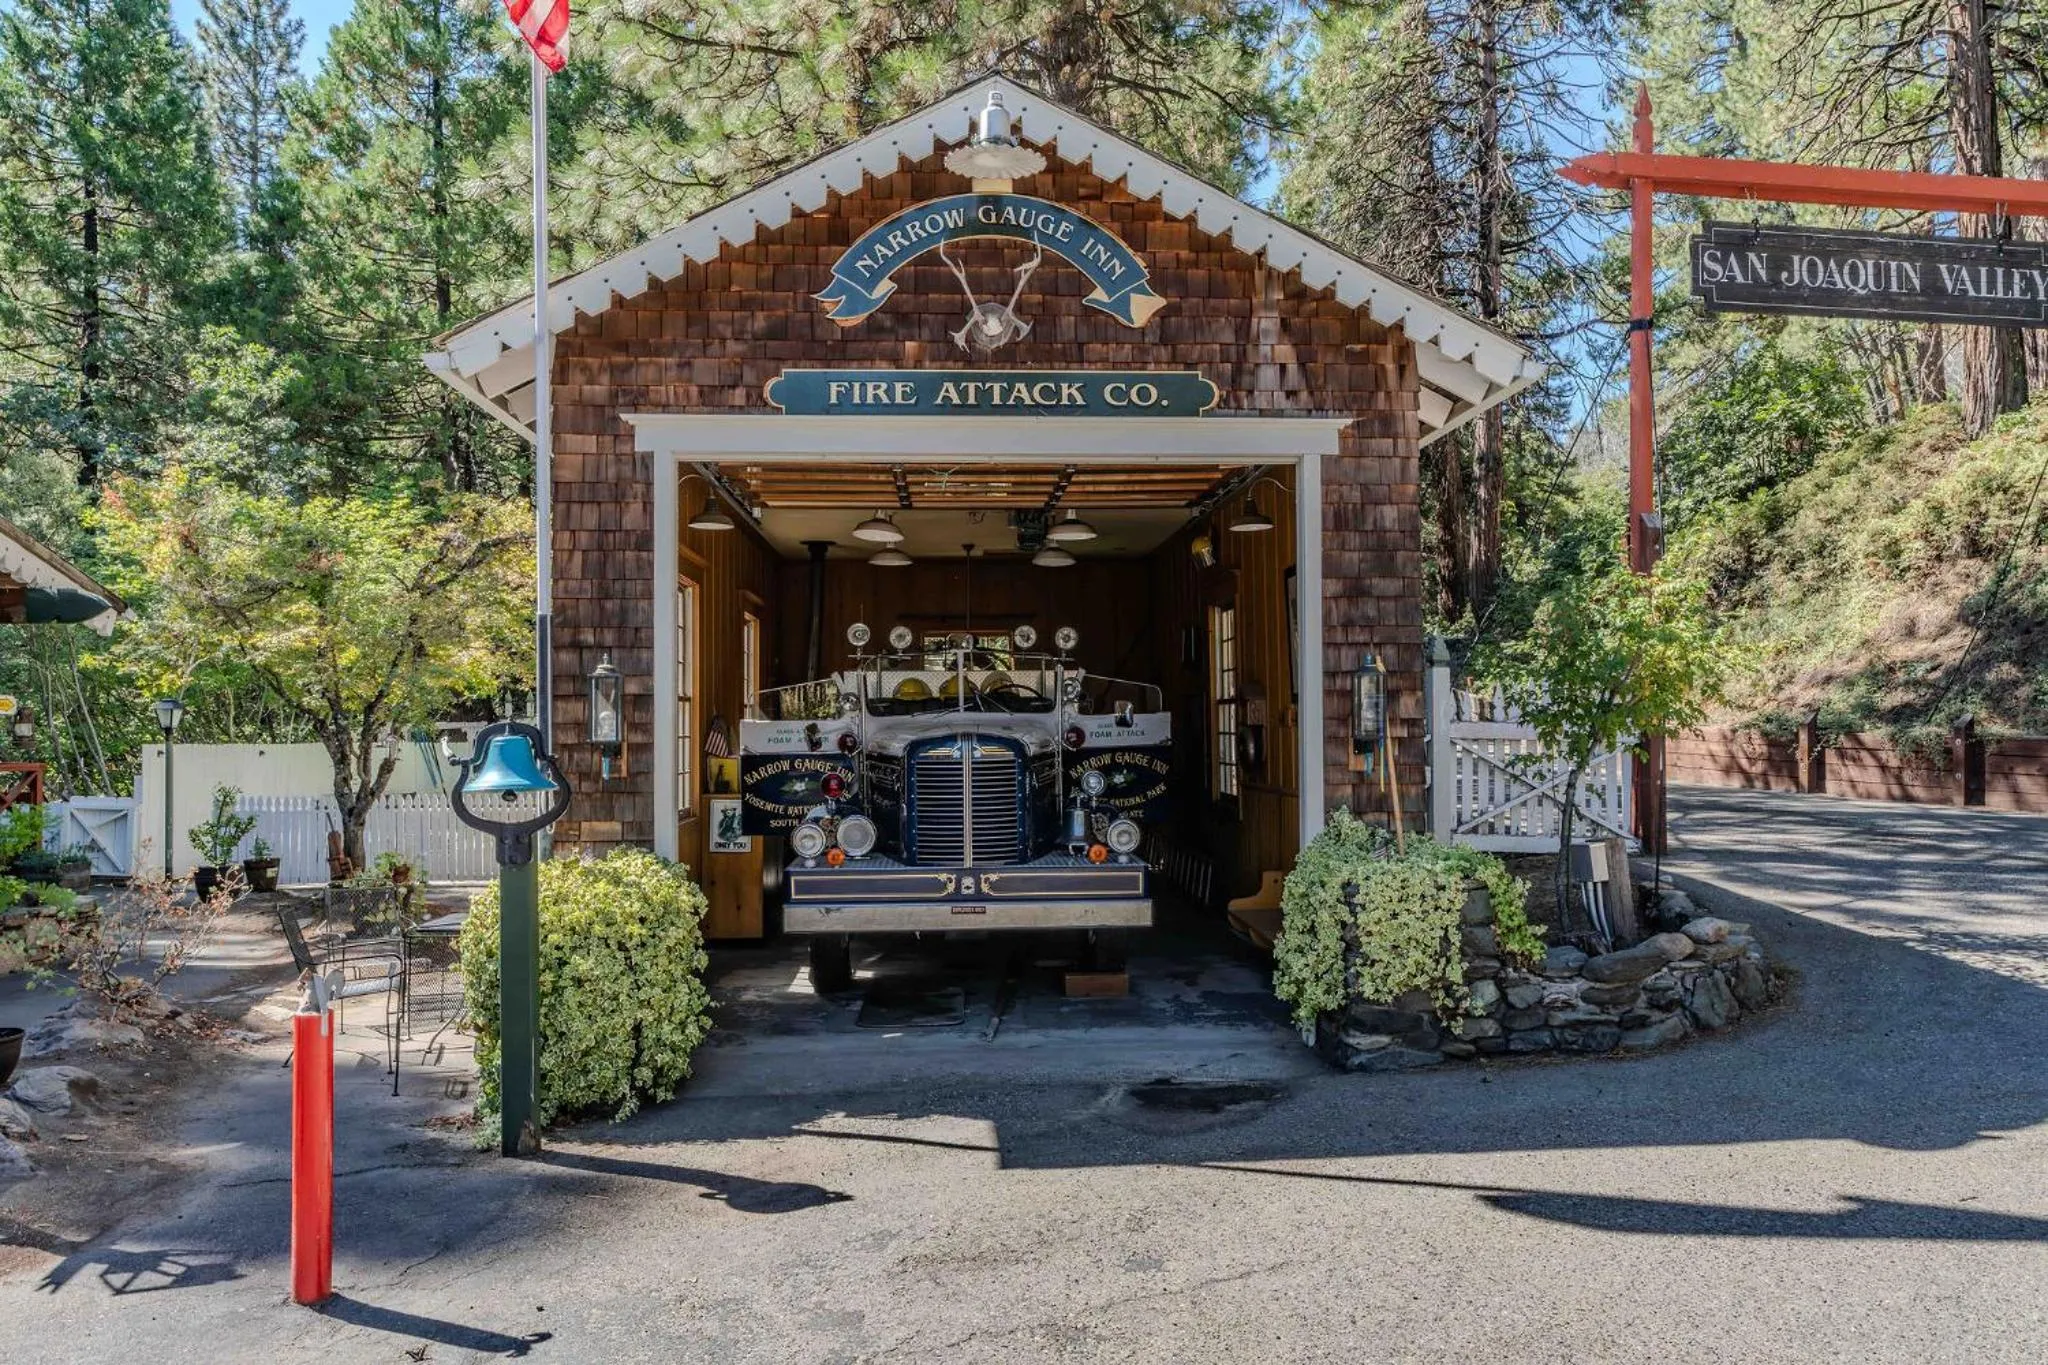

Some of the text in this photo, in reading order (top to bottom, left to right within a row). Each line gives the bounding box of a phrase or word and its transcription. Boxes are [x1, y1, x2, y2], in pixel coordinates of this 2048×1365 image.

[853, 204, 1126, 282] NARROW GAUGE INN
[1703, 249, 2048, 301] SAN JOAQUIN VALLEY
[828, 381, 1169, 407] FIRE ATTACK CO.
[1117, 729, 1146, 737] ATTACK
[744, 758, 856, 785] NARROW GAUGE INN
[1069, 751, 1170, 779] NARROW GAUGE INN
[744, 792, 785, 814] YOSEMITE
[714, 841, 746, 849] ONLY YOU
